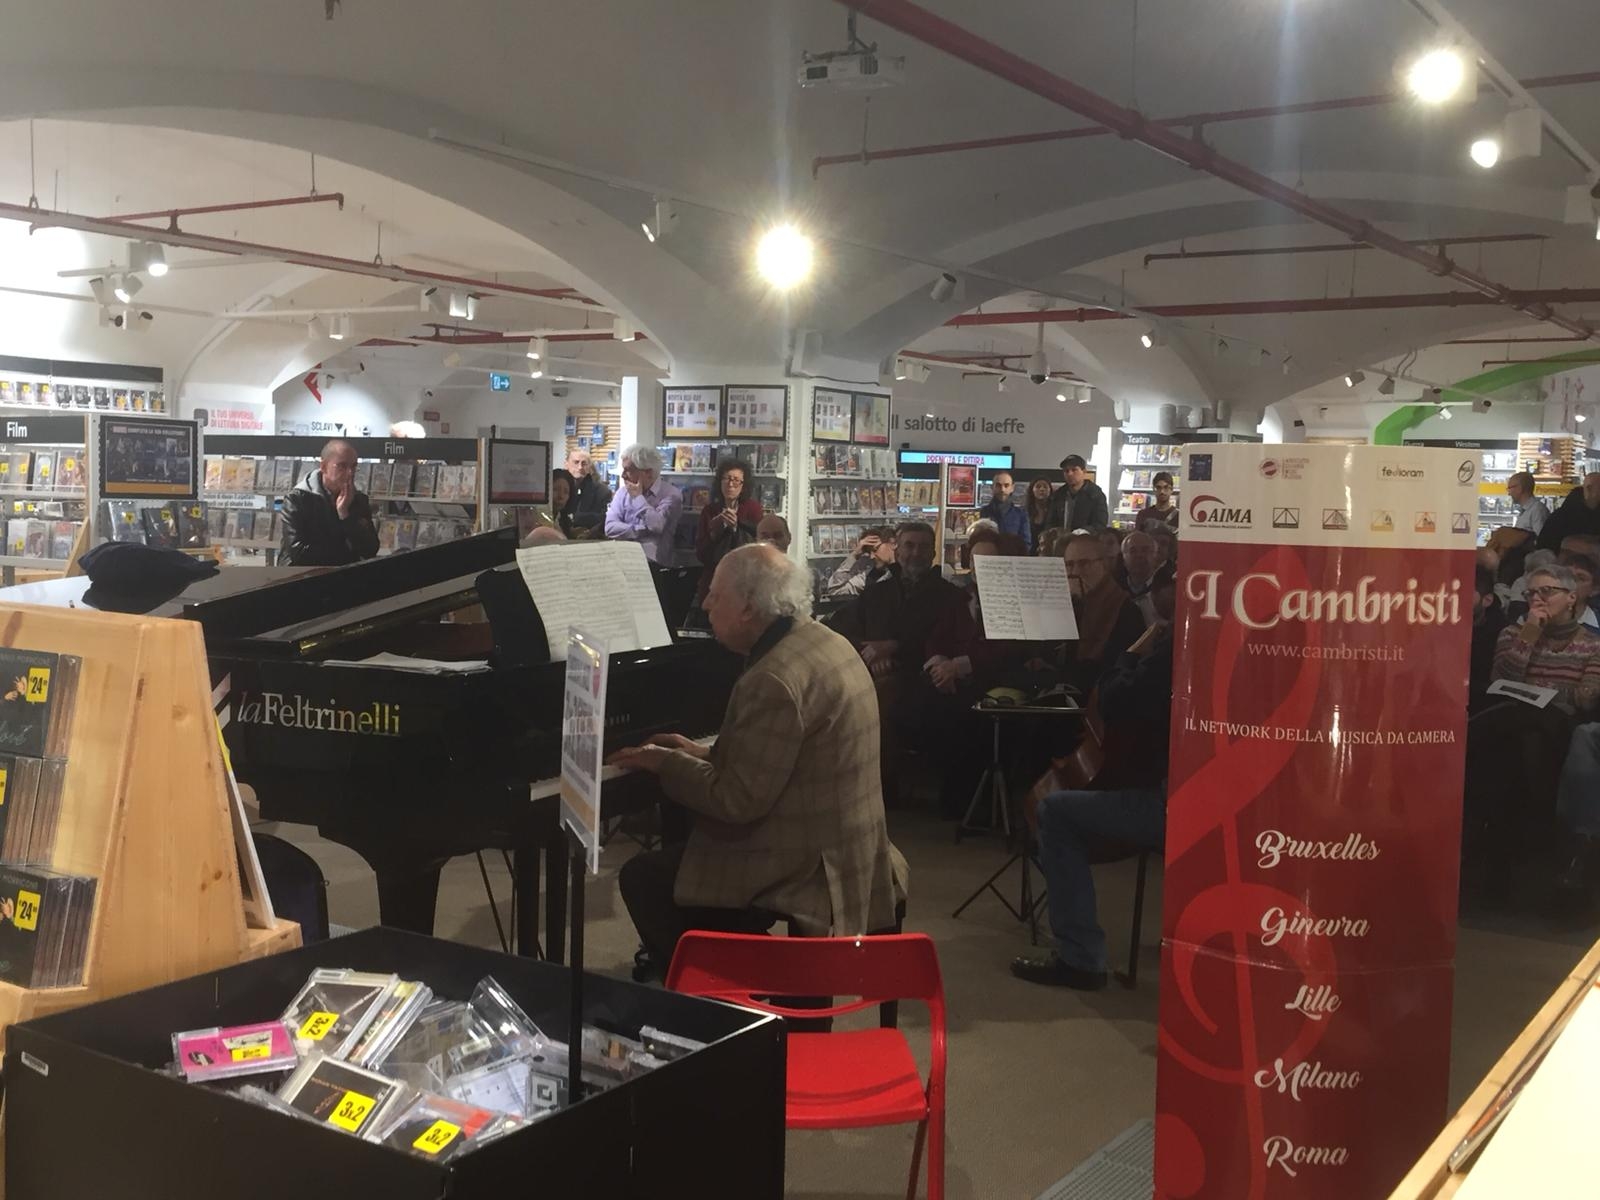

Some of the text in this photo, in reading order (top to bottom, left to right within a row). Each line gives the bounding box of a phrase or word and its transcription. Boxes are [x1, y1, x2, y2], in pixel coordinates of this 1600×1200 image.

[6, 422, 28, 438] Film
[904, 415, 957, 432] salotto
[962, 417, 976, 433] di
[981, 417, 1025, 434] laeffe
[384, 441, 405, 455] Film
[1127, 435, 1150, 444] Teatro
[1208, 508, 1252, 523] AIMA
[1186, 569, 1462, 630] I Cambristi
[1248, 642, 1405, 661] www.cambristi.it
[237, 691, 401, 737] laFeltrinelli
[1185, 716, 1456, 745] IL NETWORK DELLA MUSICA DA CAMERA
[1255, 829, 1380, 868] Bruxelles
[1261, 907, 1370, 946] Ginevra
[1285, 985, 1341, 1021] Lille
[1254, 1057, 1363, 1100] Milano
[339, 1100, 366, 1123] 3x2
[424, 1127, 452, 1146] 3x2
[1263, 1135, 1349, 1178] Roma
